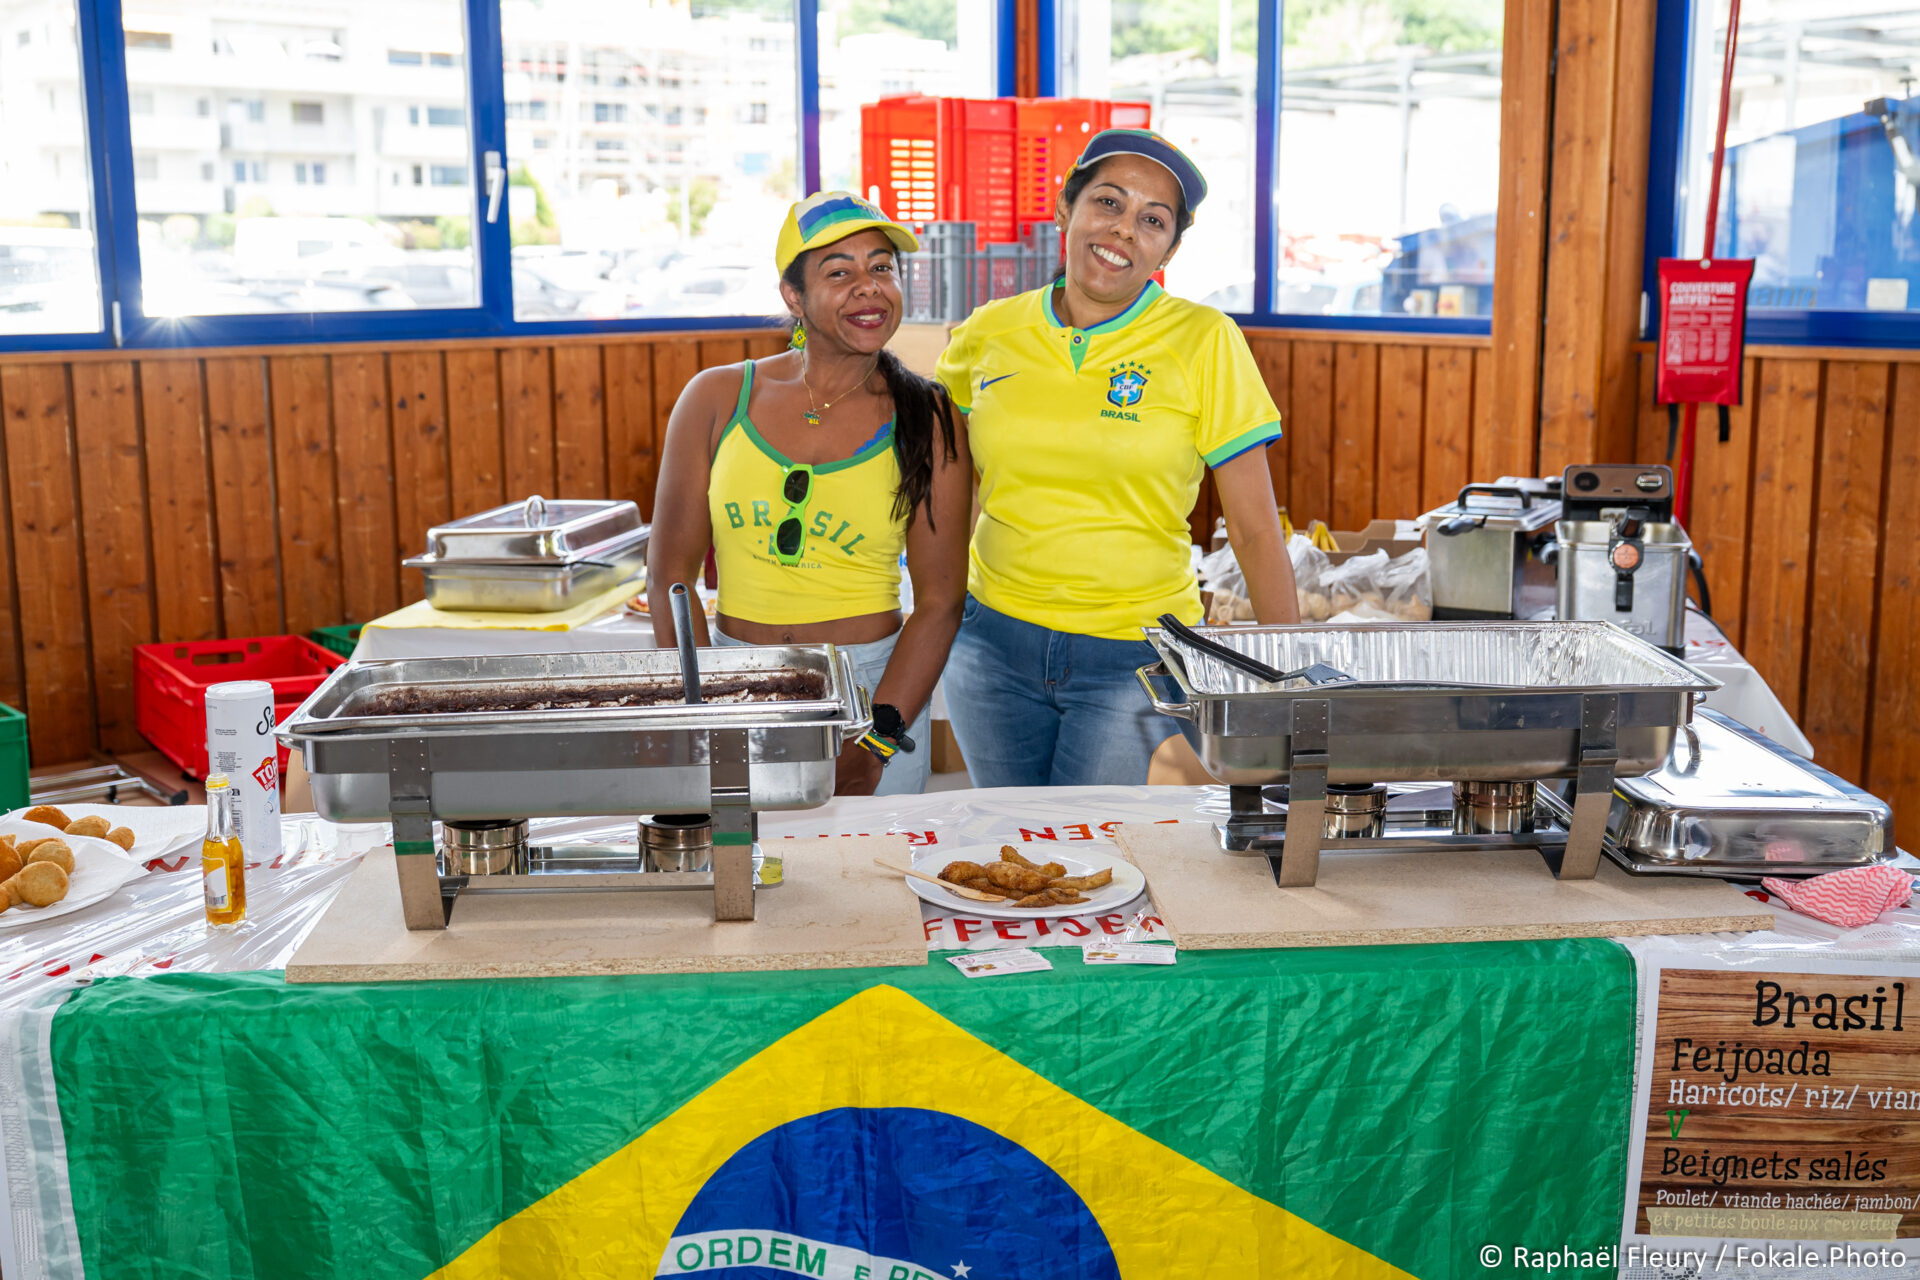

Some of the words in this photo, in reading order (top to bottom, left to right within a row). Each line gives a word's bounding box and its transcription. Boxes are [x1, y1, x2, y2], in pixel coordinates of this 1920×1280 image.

[1101, 409, 1141, 423] BRASIL
[725, 500, 866, 557] BRSIL
[1752, 980, 1905, 1032] Brasil
[1671, 1038, 1832, 1083] Feijoada
[1668, 1079, 1798, 1108] Haricots/
[1804, 1084, 1860, 1110] riz/
[1666, 1109, 1690, 1140] V
[1661, 1147, 1801, 1186] Beignets
[1808, 1152, 1888, 1182] salés
[1656, 1189, 1718, 1207] Poulet/
[1723, 1192, 1781, 1209] viande
[1785, 1193, 1849, 1211] hachée/
[1653, 1213, 1670, 1227] et
[1674, 1213, 1736, 1232] petites
[1740, 1214, 1785, 1231] boule
[1789, 1217, 1818, 1231] aux
[676, 1236, 827, 1277] ORDEM
